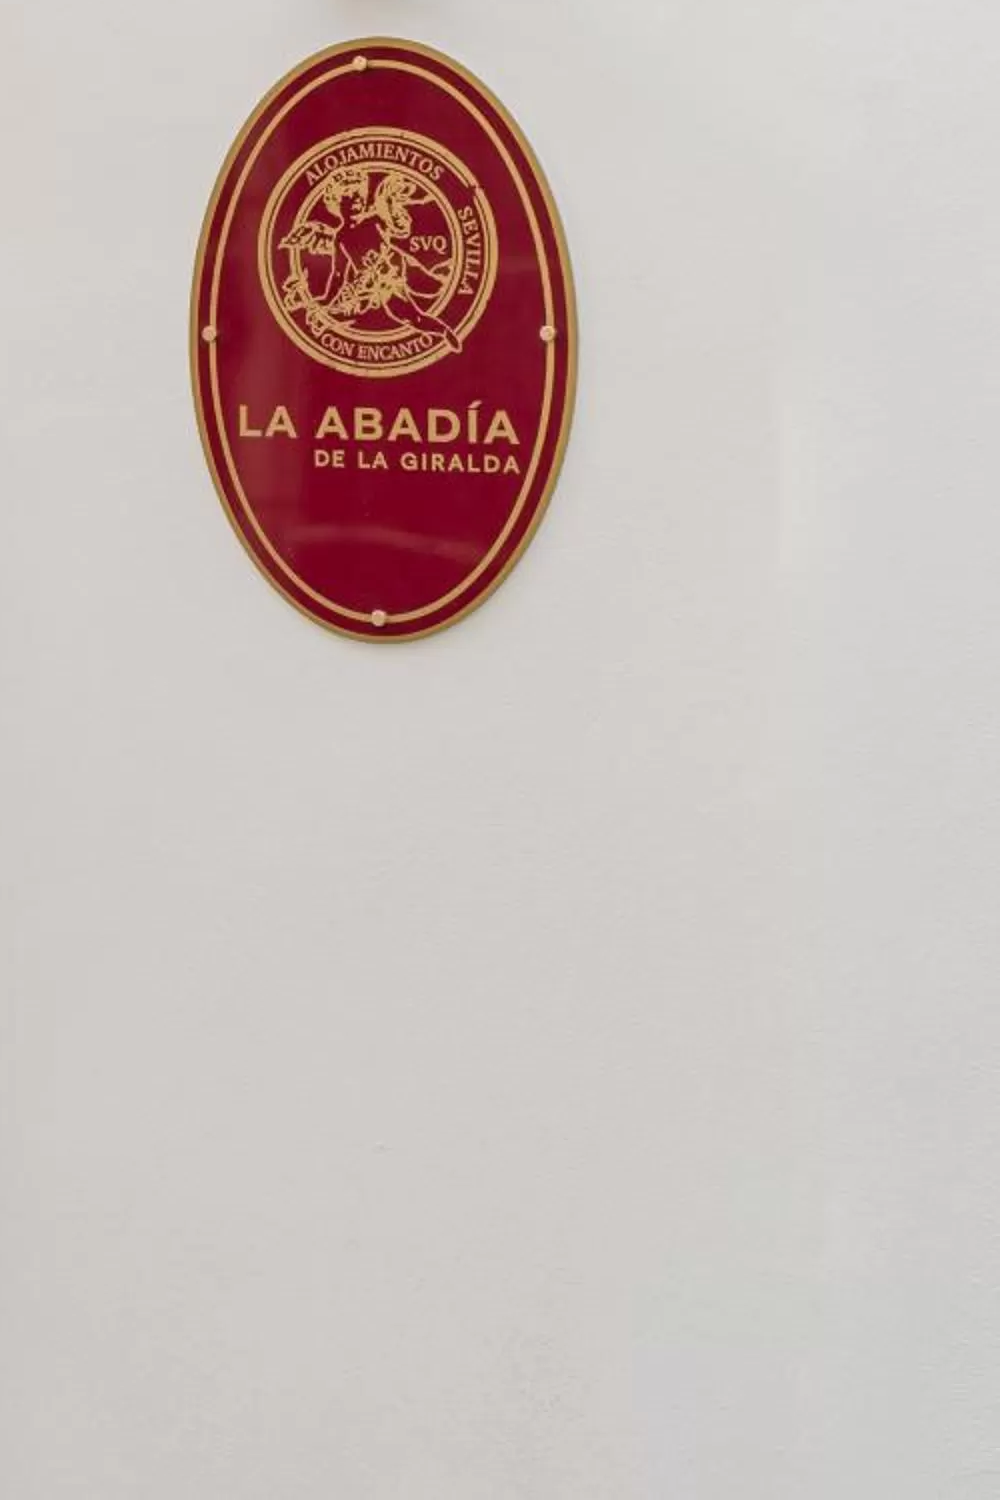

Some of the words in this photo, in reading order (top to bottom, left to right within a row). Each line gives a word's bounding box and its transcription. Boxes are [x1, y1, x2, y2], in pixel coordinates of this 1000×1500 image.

[305, 143, 445, 186] ALOJAMIENTOS
[409, 236, 448, 255] SVQ
[458, 206, 482, 295] SEVILLA
[320, 334, 355, 357] CON
[357, 334, 433, 361] ENCANTO
[239, 405, 297, 439] LA
[315, 400, 521, 445] ABADÍA
[314, 450, 345, 468] DE
[358, 451, 388, 470] LA
[400, 452, 521, 475] GIRALDA
